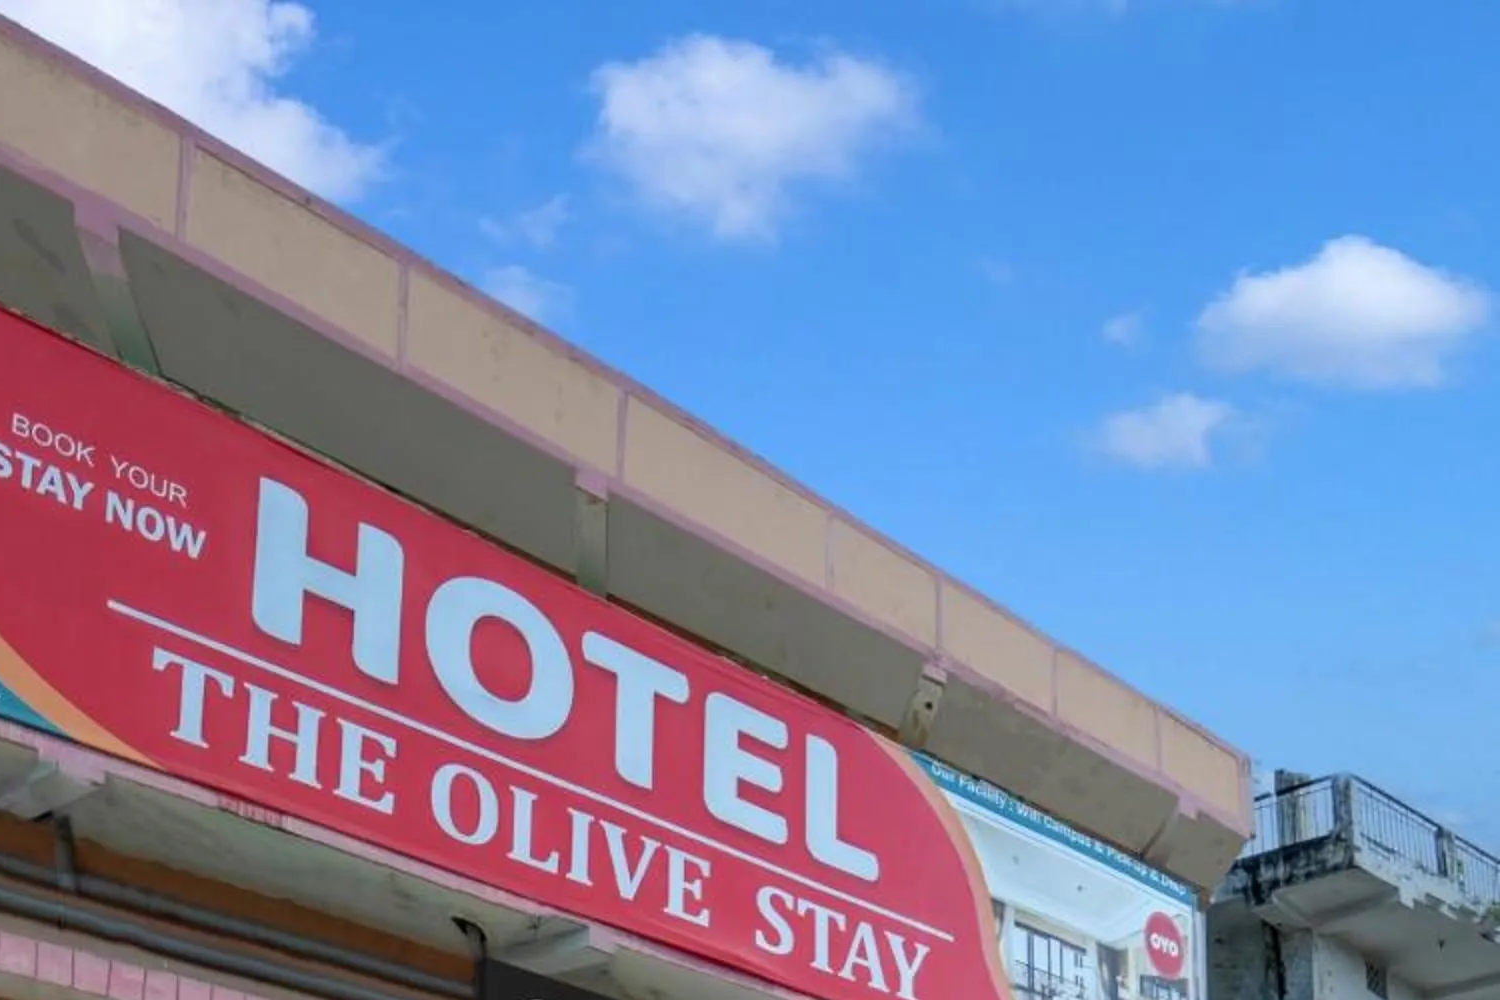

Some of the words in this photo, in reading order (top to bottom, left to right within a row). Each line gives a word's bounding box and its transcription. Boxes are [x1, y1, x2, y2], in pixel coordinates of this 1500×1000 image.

[11, 411, 97, 468] BOOK
[109, 454, 189, 509] YOUR
[104, 491, 208, 560] NOW
[251, 475, 880, 882] HOTEL
[152, 646, 398, 815] THE
[428, 761, 712, 928] OLIVE
